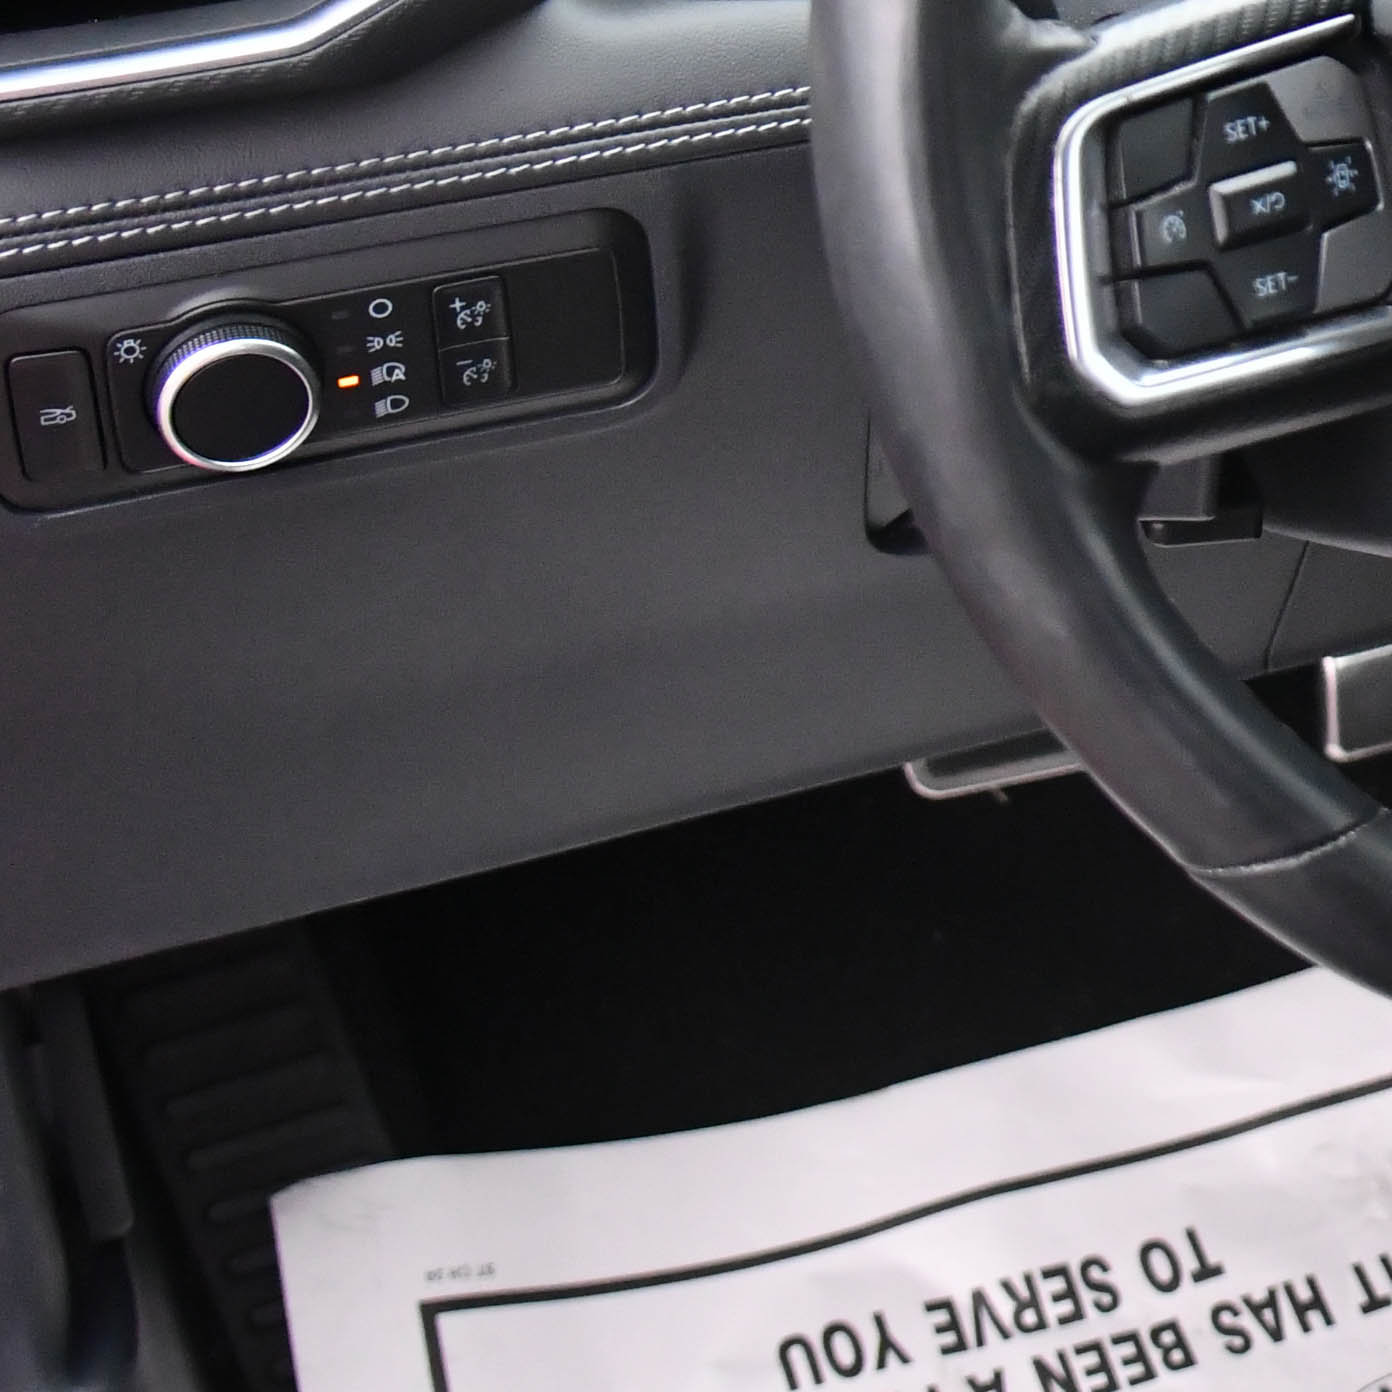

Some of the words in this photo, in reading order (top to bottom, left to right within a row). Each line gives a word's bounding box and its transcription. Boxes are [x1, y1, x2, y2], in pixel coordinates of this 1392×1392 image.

[1223, 116, 1271, 144] SET+
[1138, 1226, 1225, 1295] TO
[925, 1256, 1120, 1355] SERVE
[1210, 1273, 1336, 1356] HAS
[777, 1310, 911, 1391] YOU
[1031, 1318, 1197, 1392] BEEN
